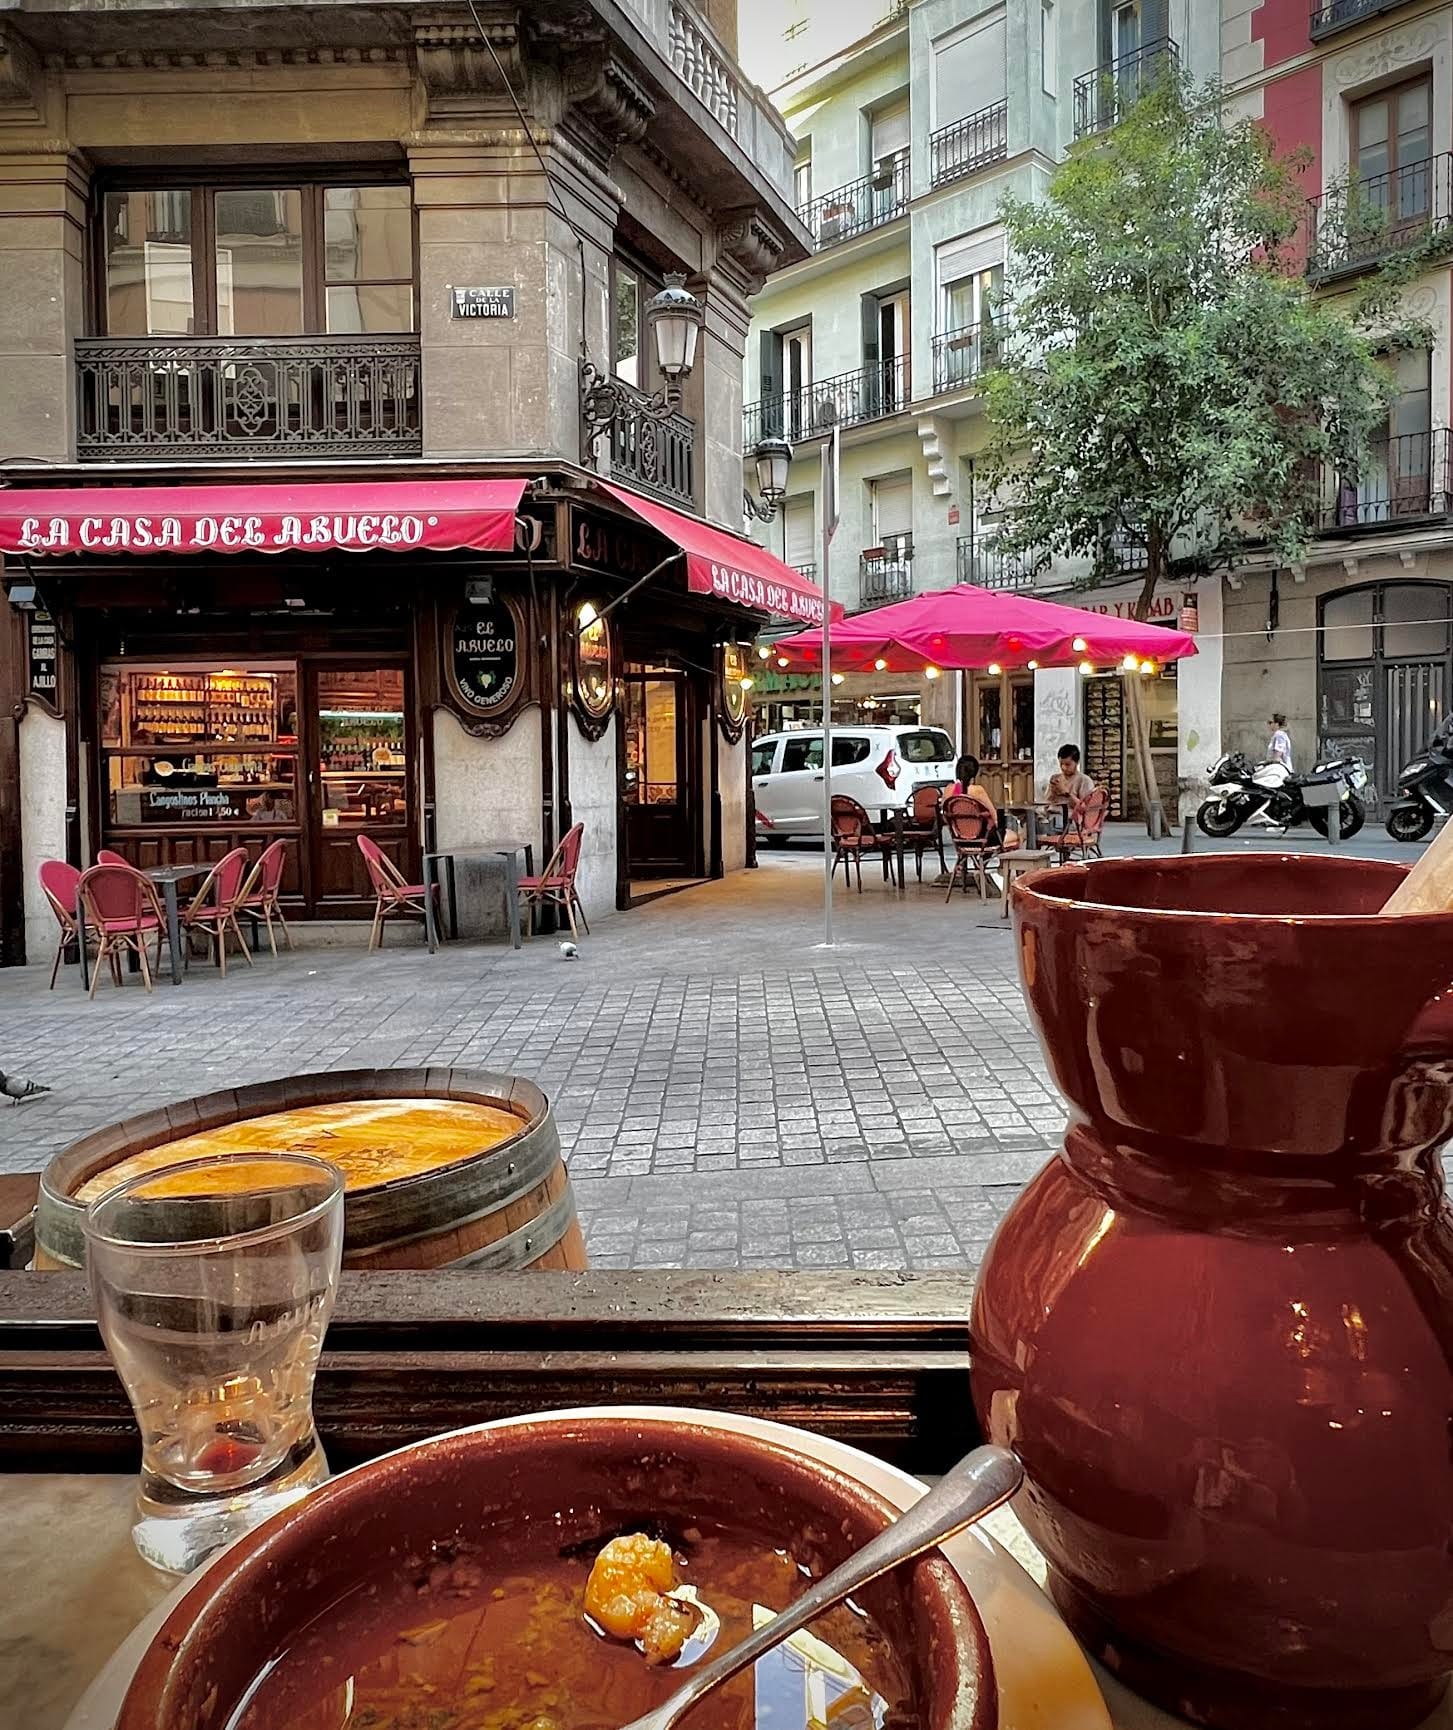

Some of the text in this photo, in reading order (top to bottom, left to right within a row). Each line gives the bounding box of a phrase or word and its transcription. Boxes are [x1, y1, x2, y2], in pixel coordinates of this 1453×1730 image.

[469, 289, 510, 297] CALLE
[459, 304, 508, 316] VICTORIA
[17, 516, 70, 547] LA
[78, 516, 182, 547] CASA
[188, 514, 264, 546] DEL
[711, 563, 828, 622] LA CASA DEL ABUEL
[1114, 602, 1123, 618] Y
[476, 622, 494, 635] EL
[456, 639, 514, 653] ABUELO
[459, 677, 513, 705] VINO GENEROSO
